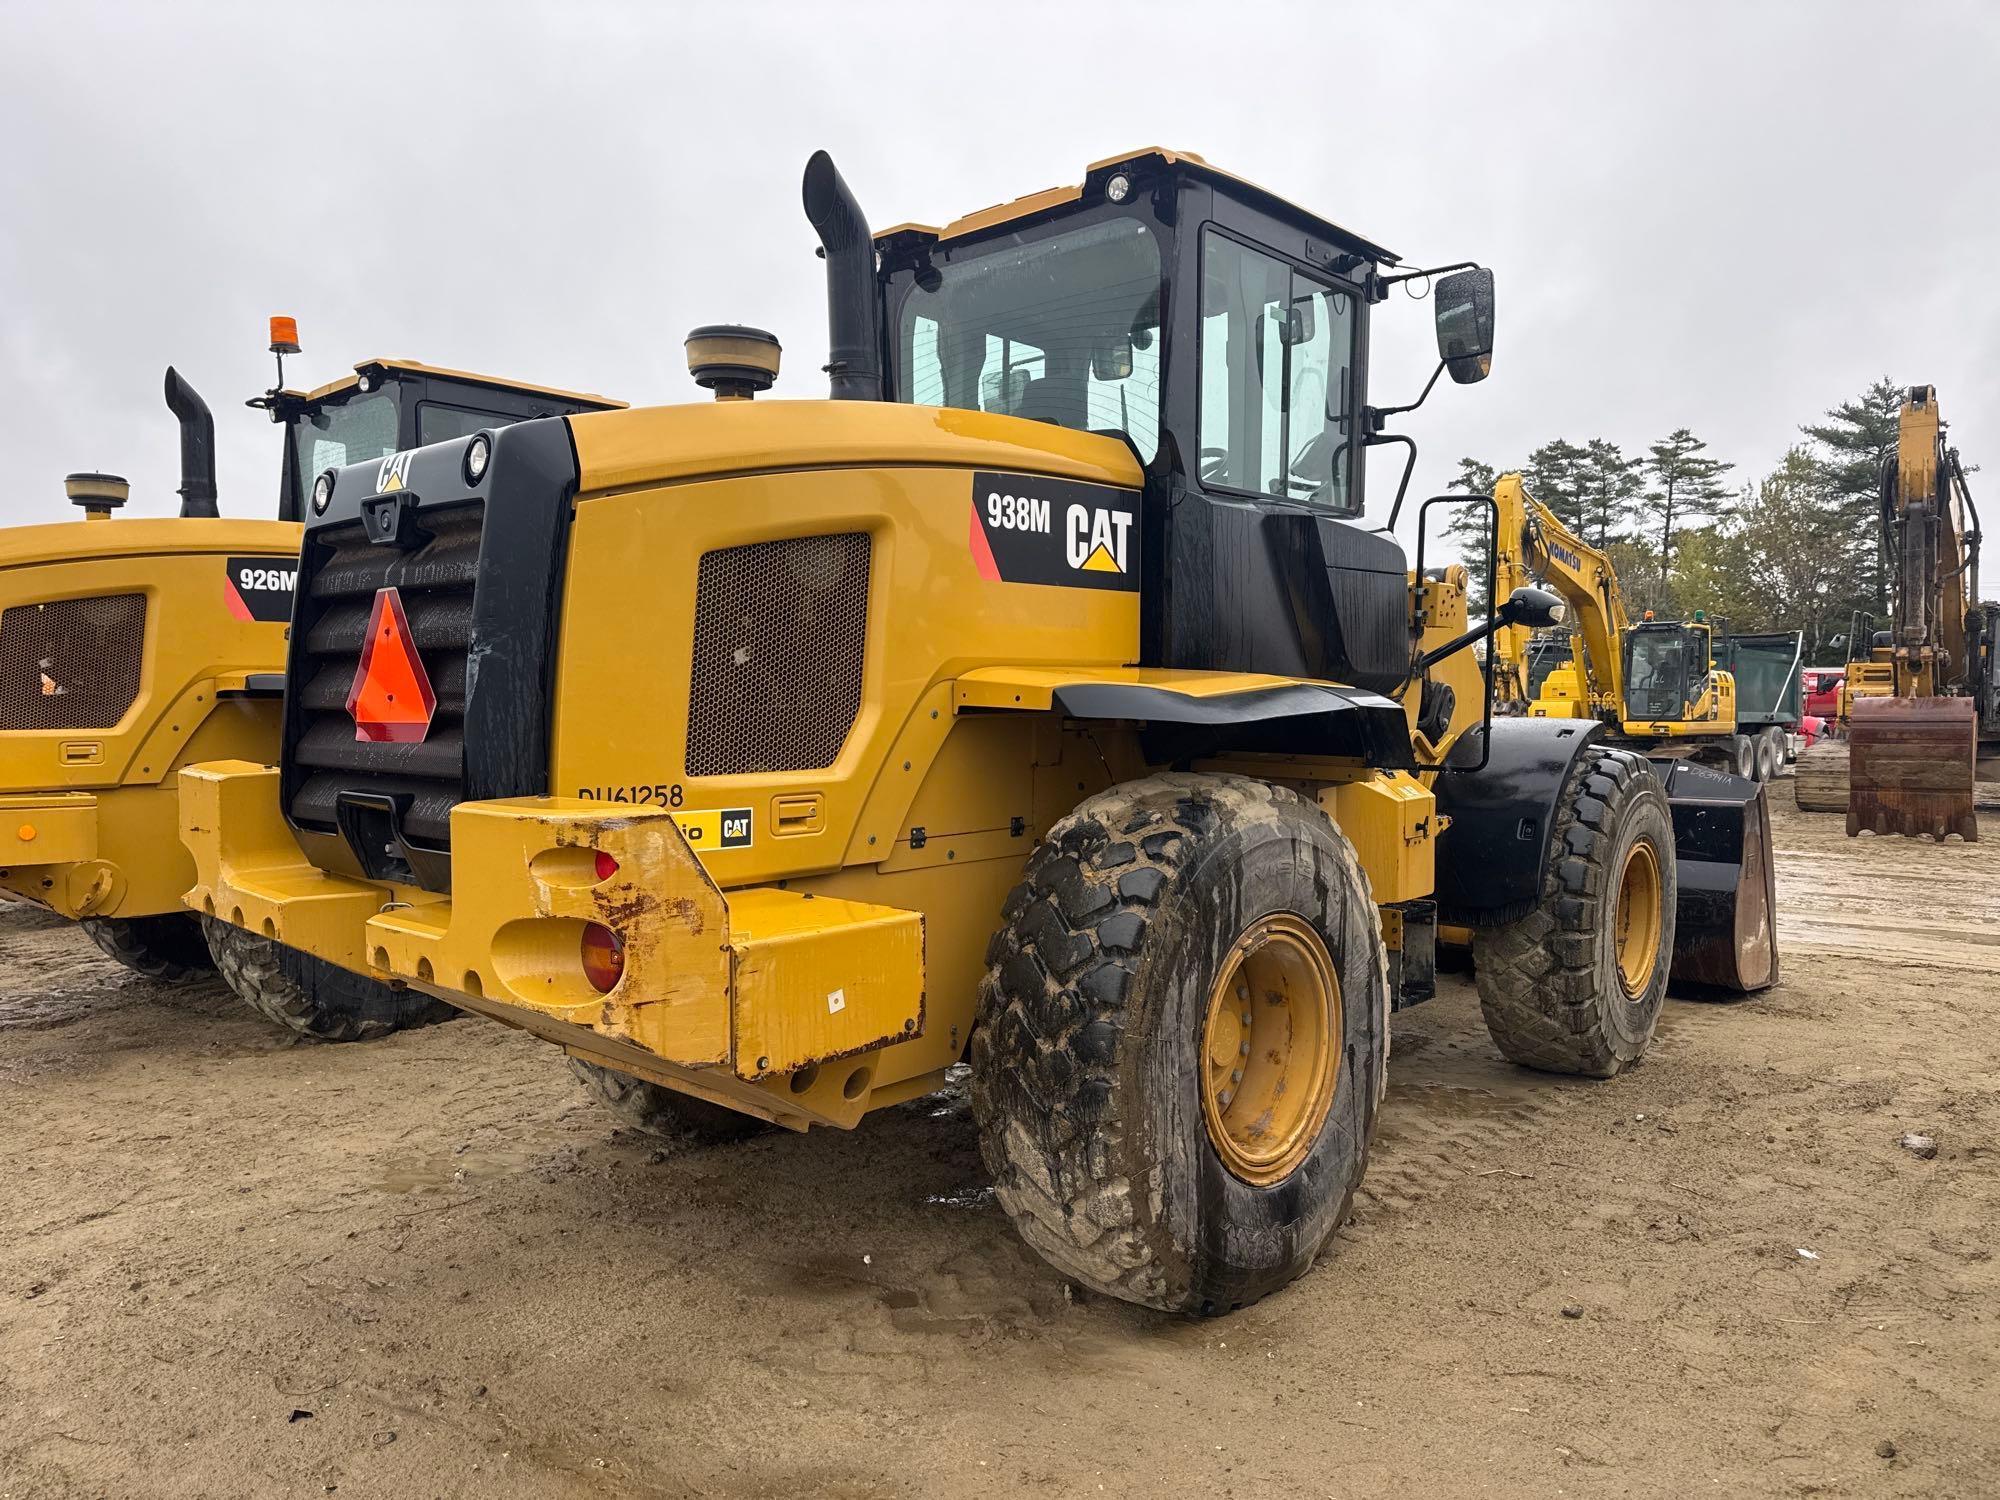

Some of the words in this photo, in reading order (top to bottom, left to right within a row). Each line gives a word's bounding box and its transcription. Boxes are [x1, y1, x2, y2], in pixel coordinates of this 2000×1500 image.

[375, 448, 420, 494] CAT
[987, 492, 1050, 534] 938M
[1066, 503, 1133, 574] CAT
[1549, 540, 1581, 573] KOMATSU
[240, 568, 298, 592] 926M
[724, 818, 749, 838] CAT
